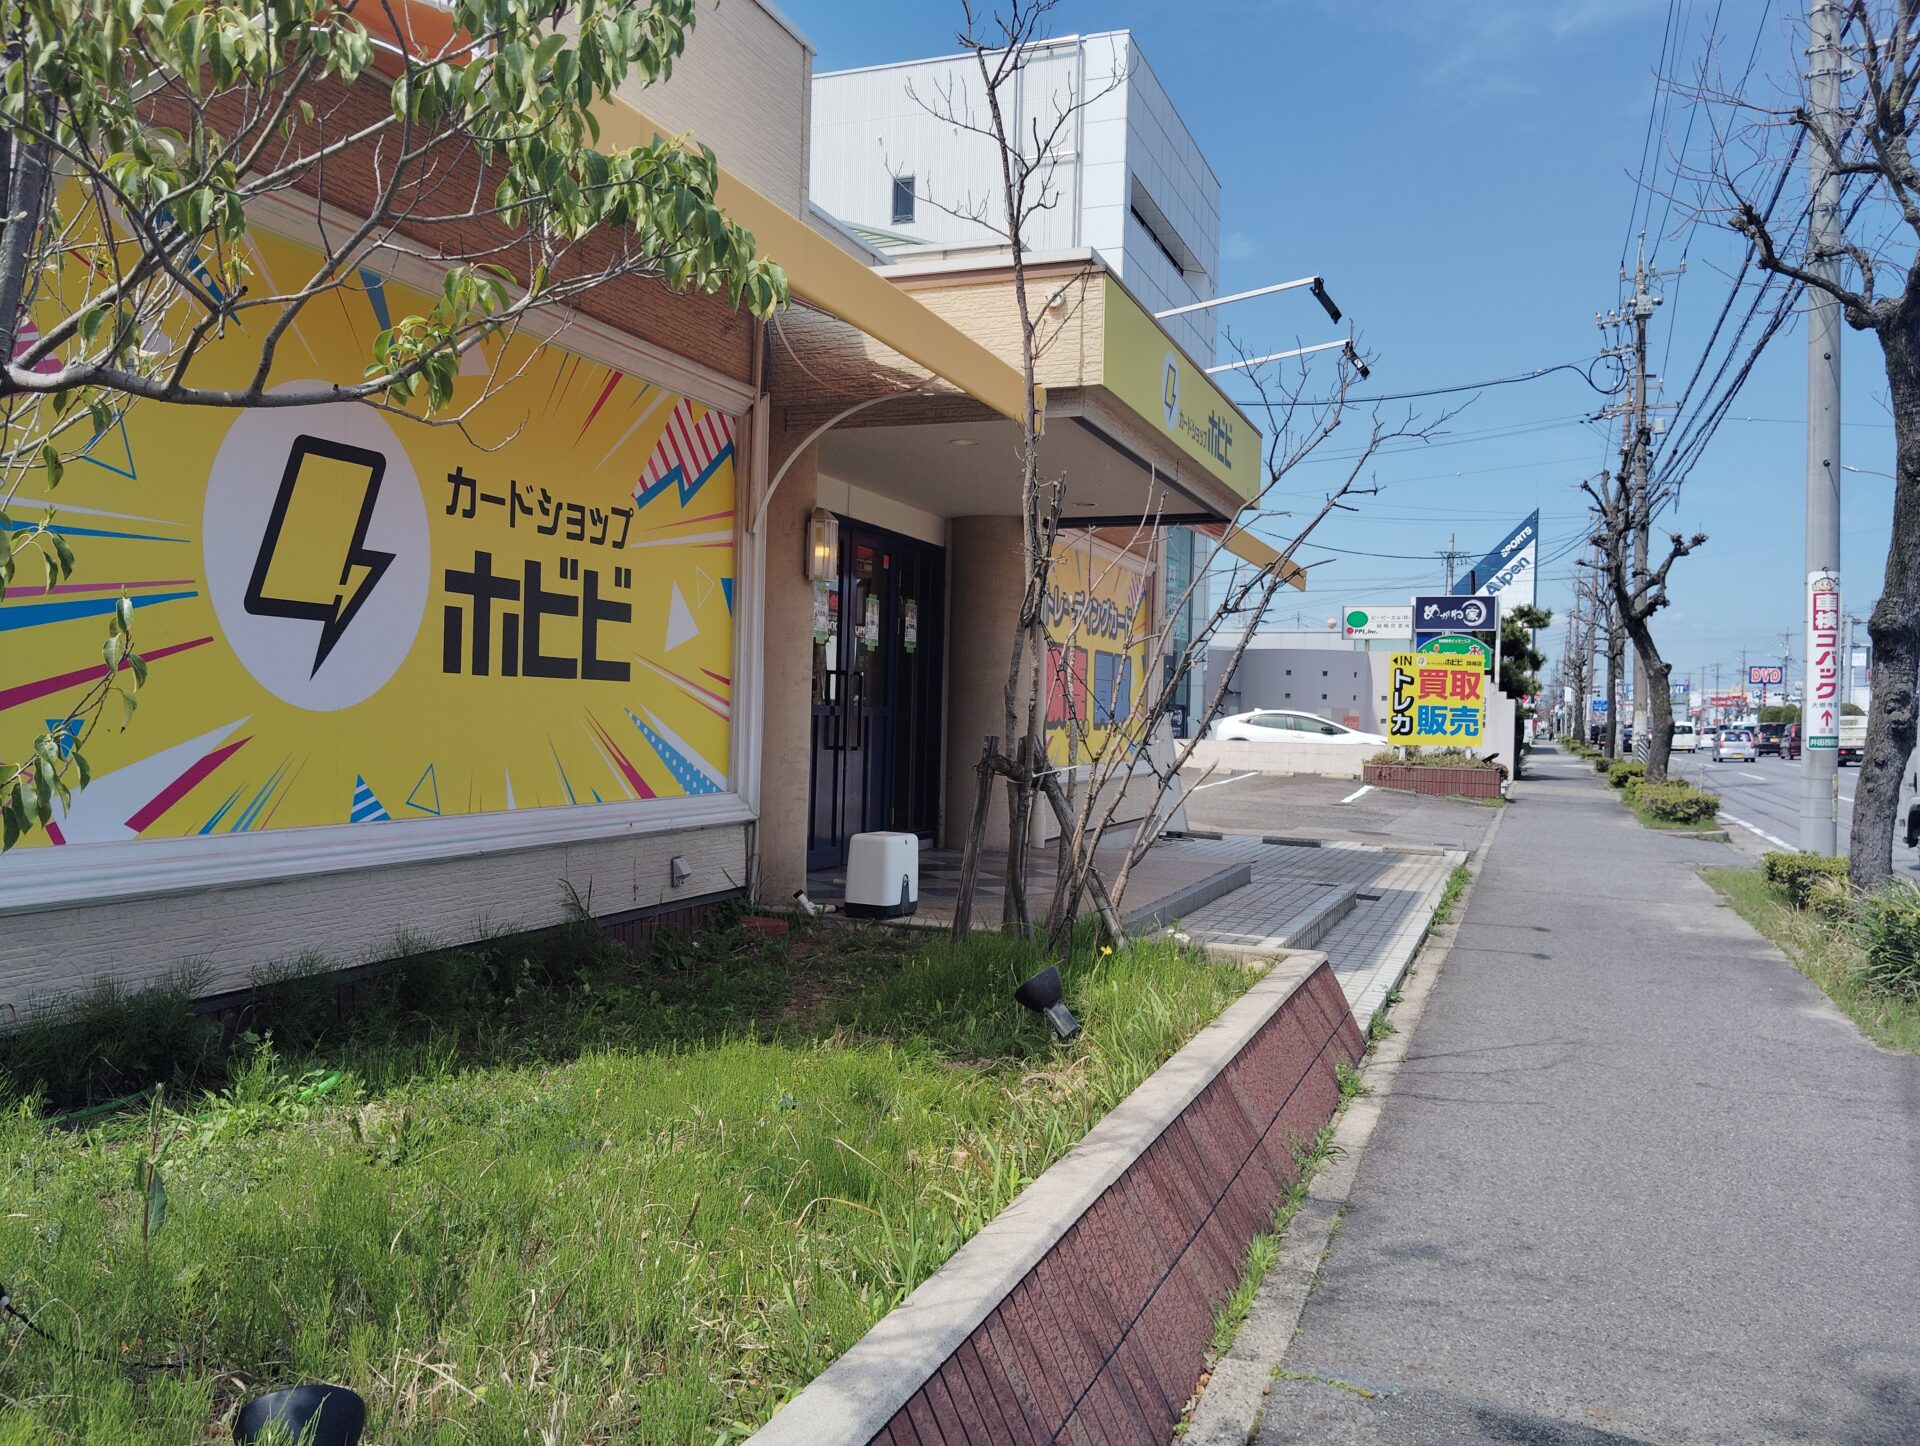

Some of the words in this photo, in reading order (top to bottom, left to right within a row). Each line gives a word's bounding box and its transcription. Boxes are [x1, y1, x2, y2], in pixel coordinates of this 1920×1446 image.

[1179, 409, 1207, 450] カードショップ
[1208, 409, 1232, 470] ホビビ
[446, 466, 634, 549] カードショップ
[1501, 526, 1533, 558] SPORTS
[1486, 557, 1530, 595] Alpen
[443, 551, 632, 682] ホビビ
[1400, 656, 1412, 666] IN
[1751, 667, 1782, 682] DVD
[1816, 634, 1837, 699] コバック
[1391, 668, 1414, 736] トレカ
[1418, 670, 1481, 701] 買取
[1417, 705, 1480, 736] 販売
